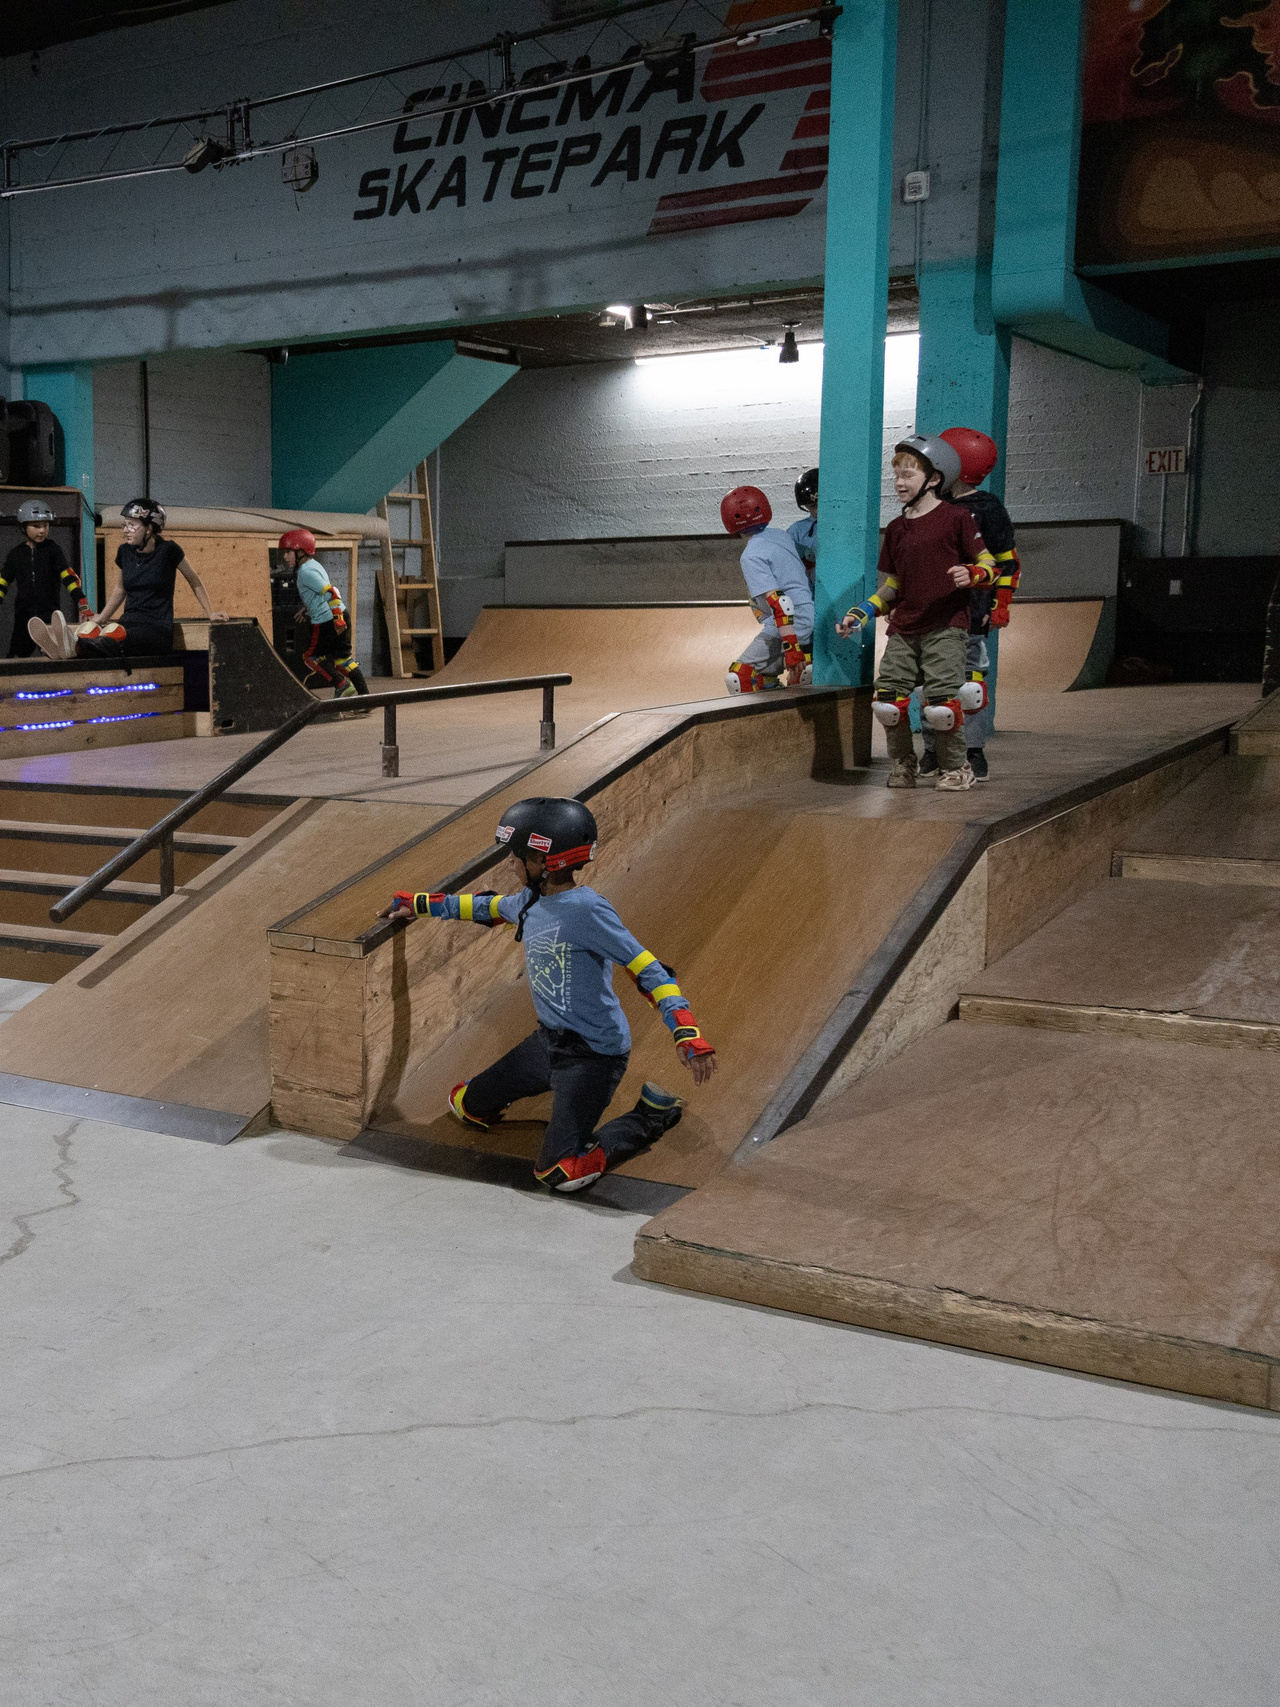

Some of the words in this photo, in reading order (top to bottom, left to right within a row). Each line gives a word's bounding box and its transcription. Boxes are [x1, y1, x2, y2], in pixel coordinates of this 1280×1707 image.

[393, 34, 697, 154] CINEMA
[353, 103, 765, 220] SKATEPARK
[1148, 450, 1182, 473] EXIT
